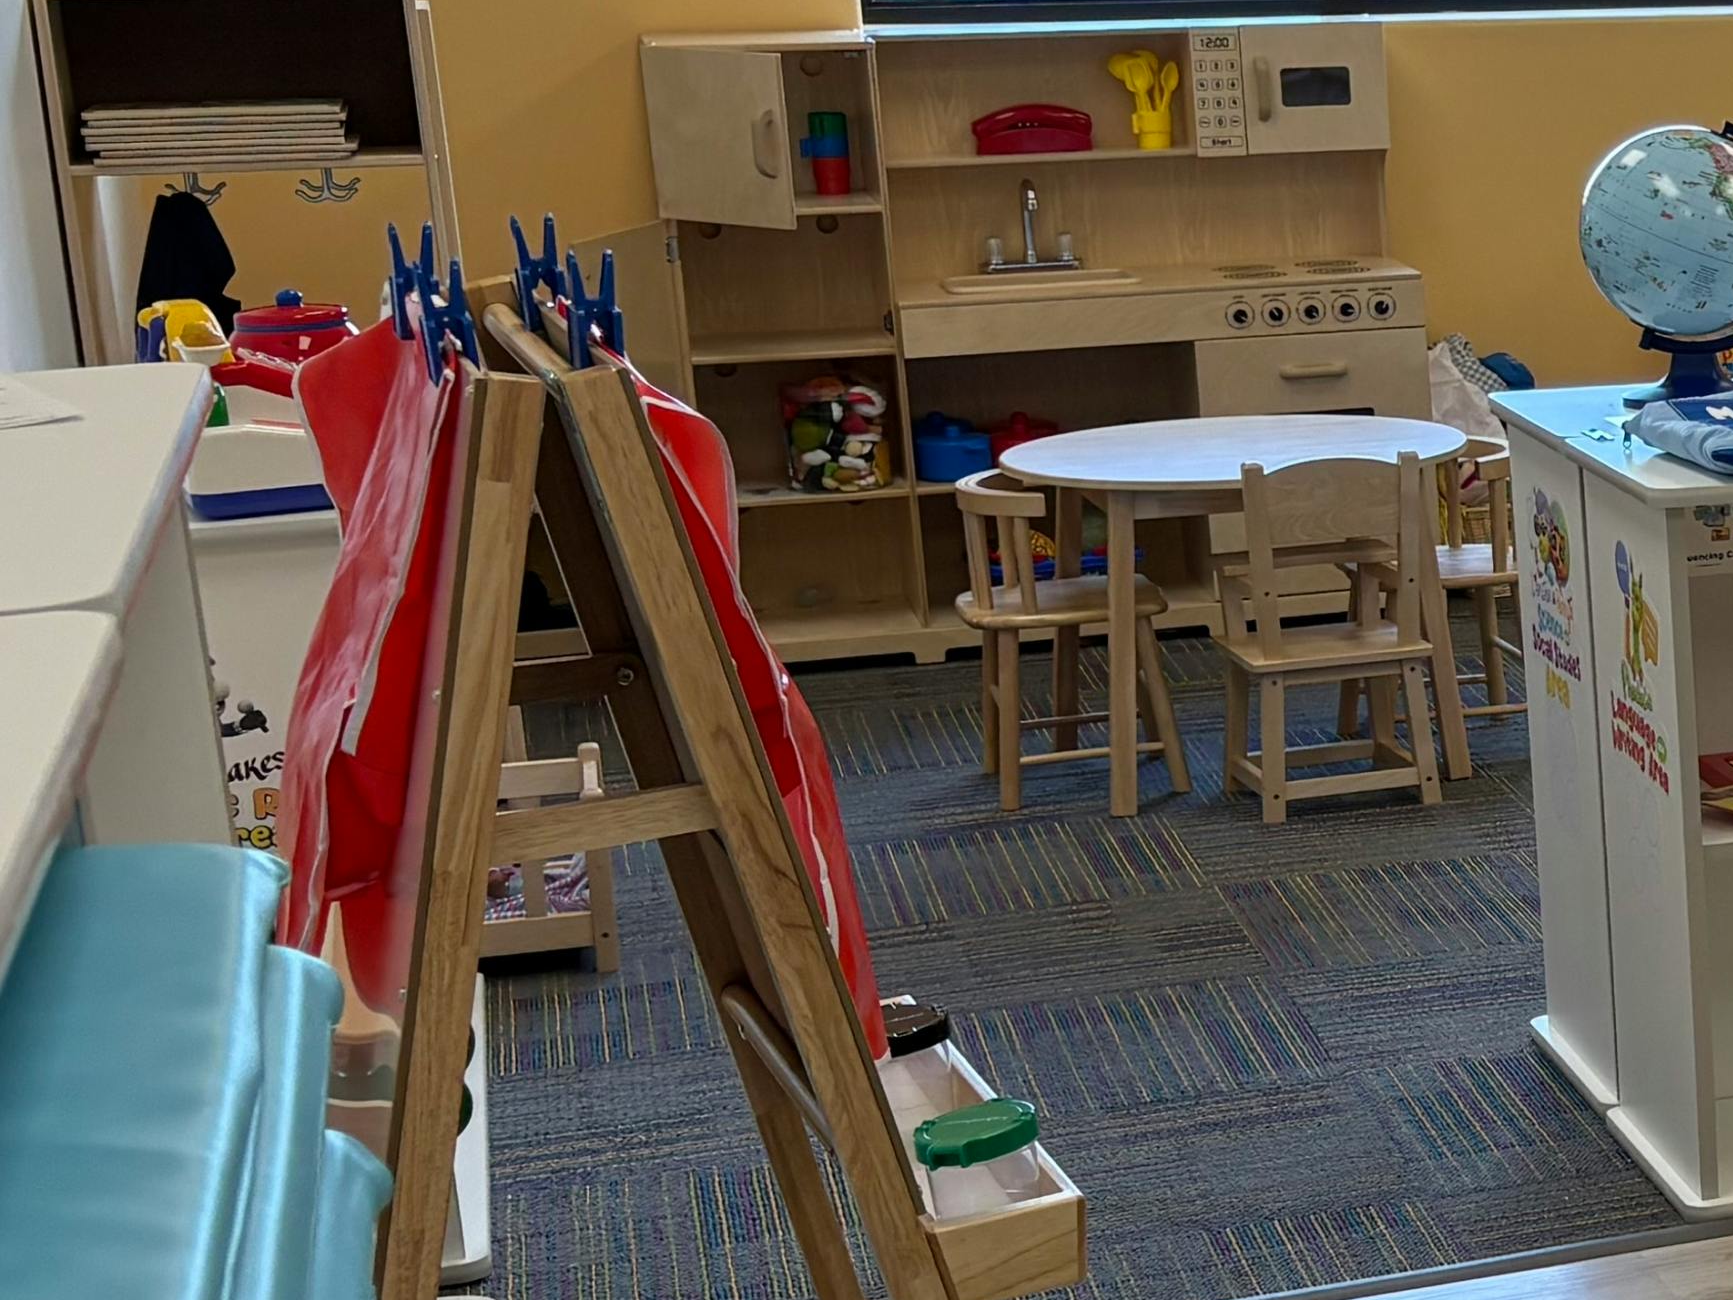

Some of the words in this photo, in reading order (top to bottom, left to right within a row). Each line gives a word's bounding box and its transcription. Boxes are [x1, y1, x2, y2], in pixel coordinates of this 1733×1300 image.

[1200, 37, 1229, 48] 12:00
[1610, 689, 1656, 752] Language
[227, 751, 285, 783] akes
[1611, 718, 1645, 774] Writing
[1648, 751, 1669, 796] Area
